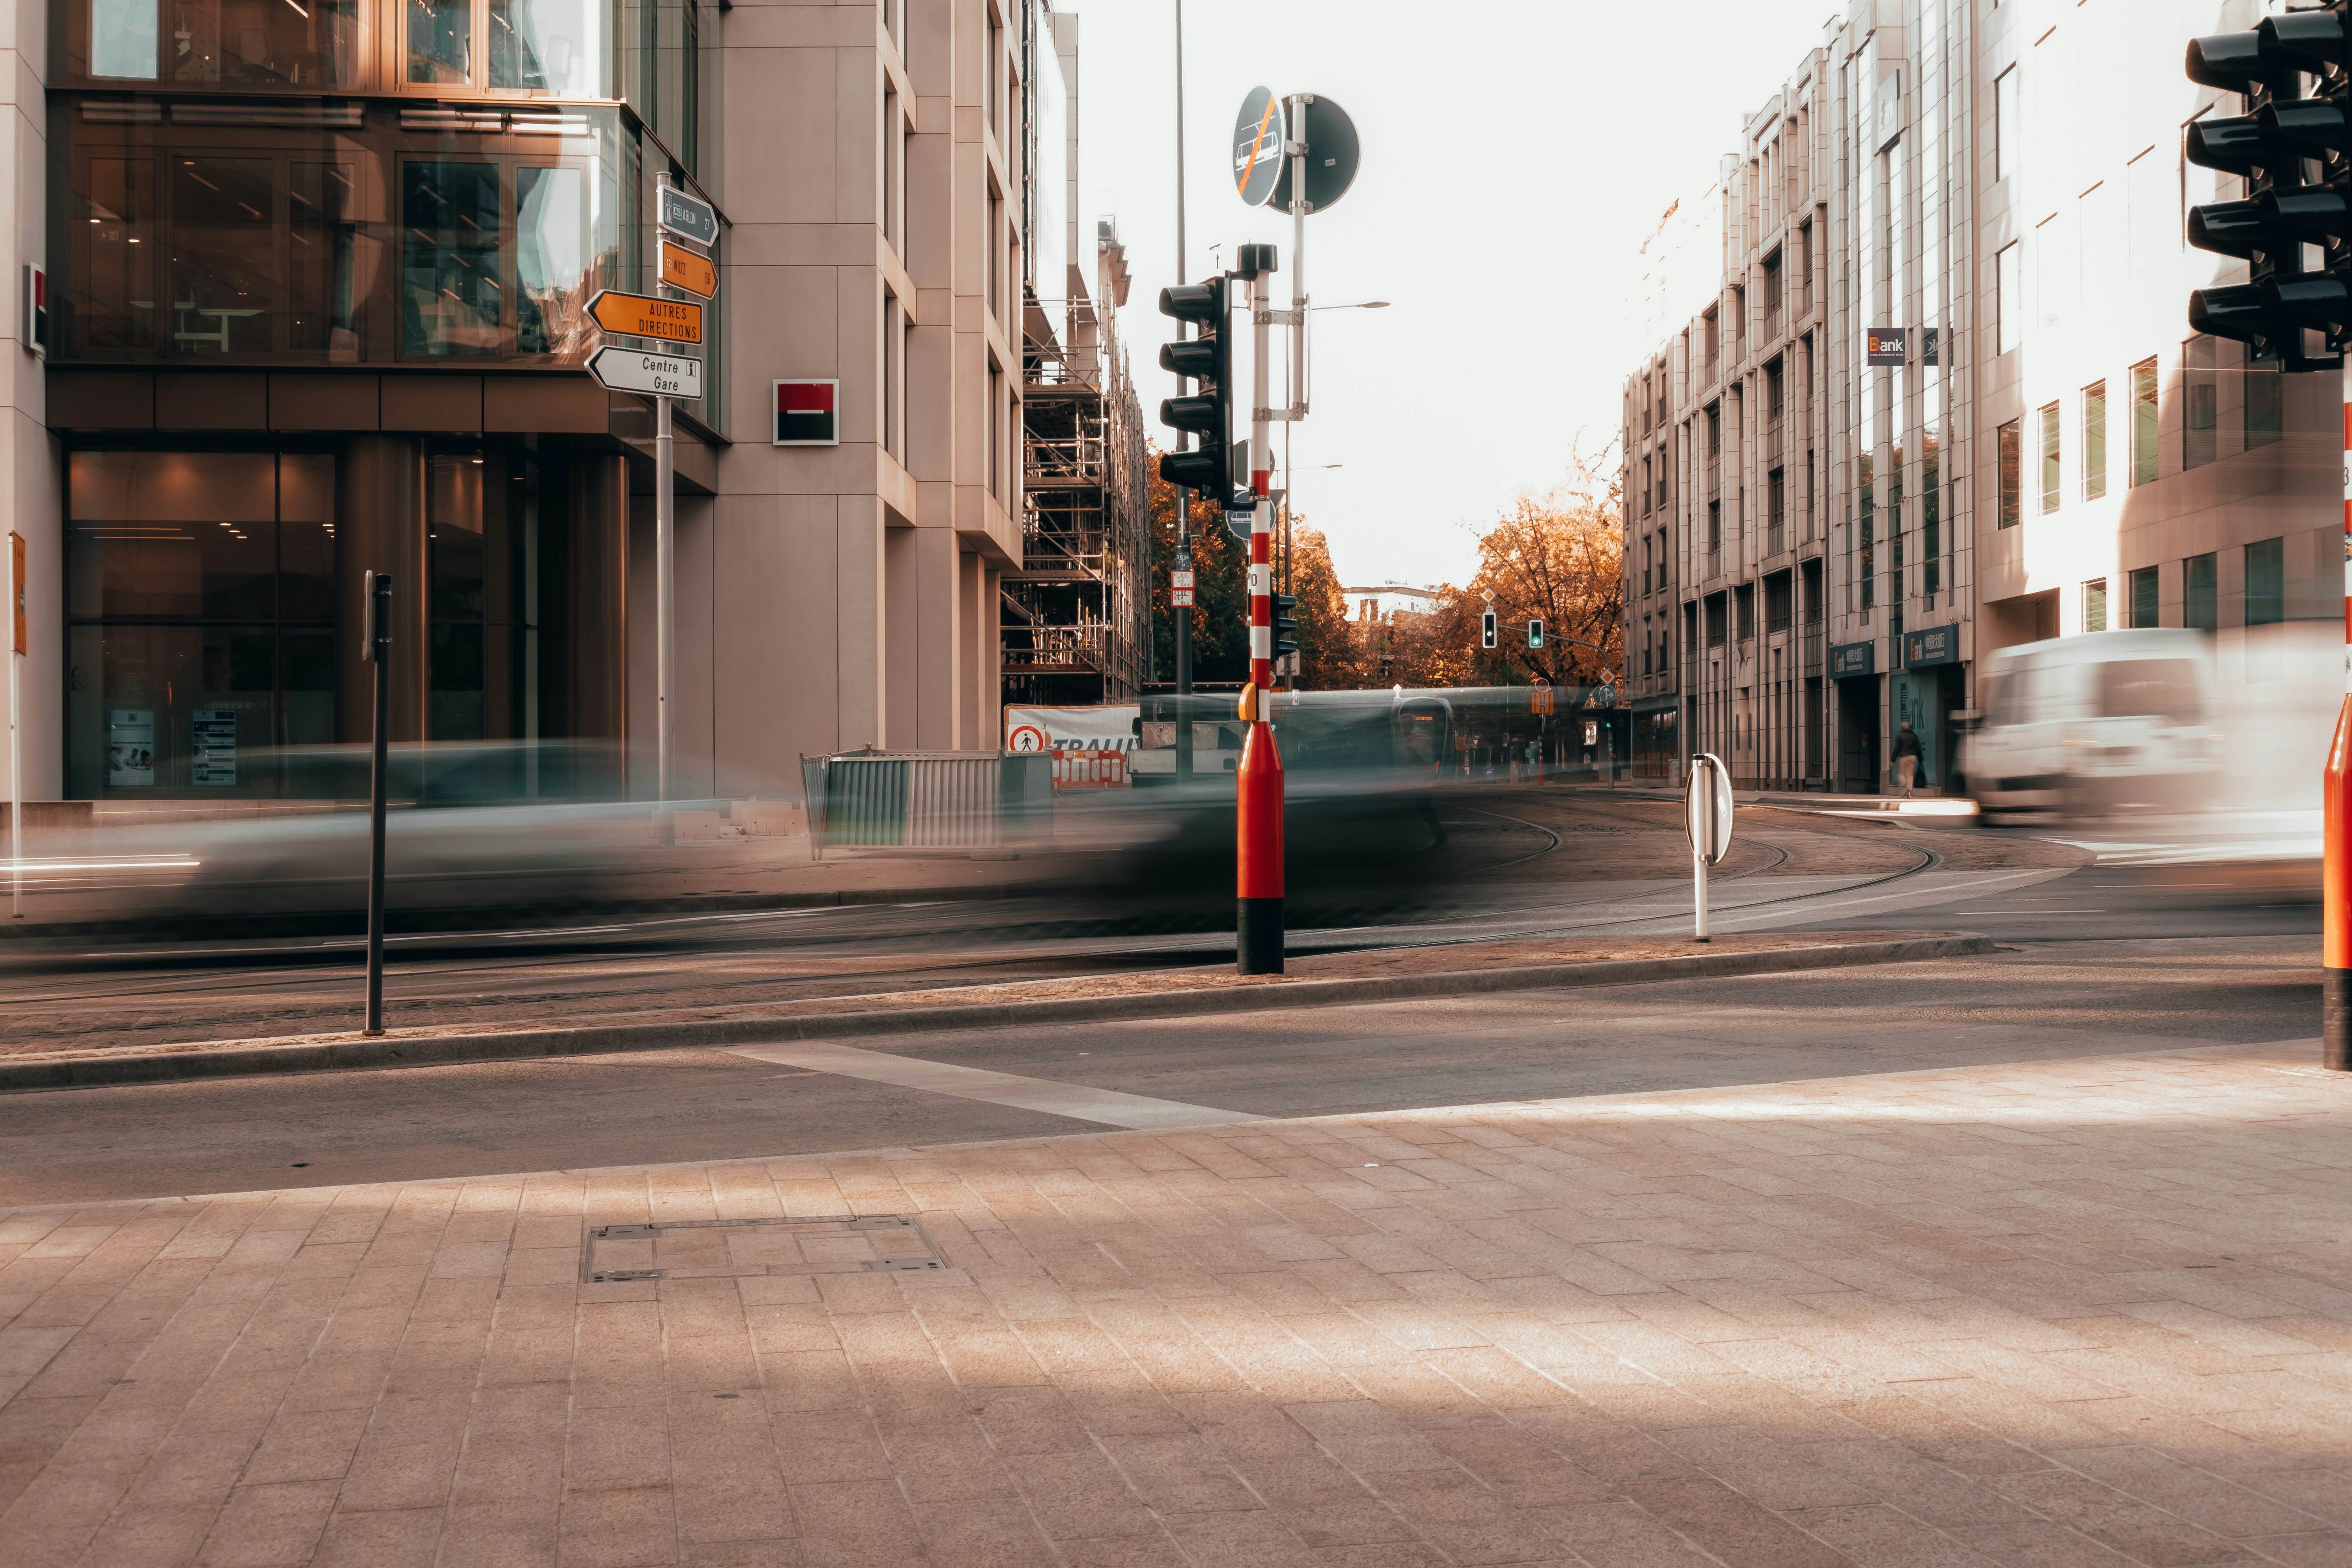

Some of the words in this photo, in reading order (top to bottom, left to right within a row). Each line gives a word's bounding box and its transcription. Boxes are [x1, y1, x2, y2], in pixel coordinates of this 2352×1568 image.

[683, 209, 696, 225] ARLON
[704, 218, 710, 231] 27
[666, 258, 671, 268] 12
[673, 259, 686, 275] WILTZ
[705, 272, 710, 285] 56
[650, 303, 686, 320] AUTRES
[639, 319, 697, 339] DIRECTIONS
[1869, 336, 1904, 352] Bank
[642, 357, 678, 374] Centre
[654, 376, 678, 391] Gare
